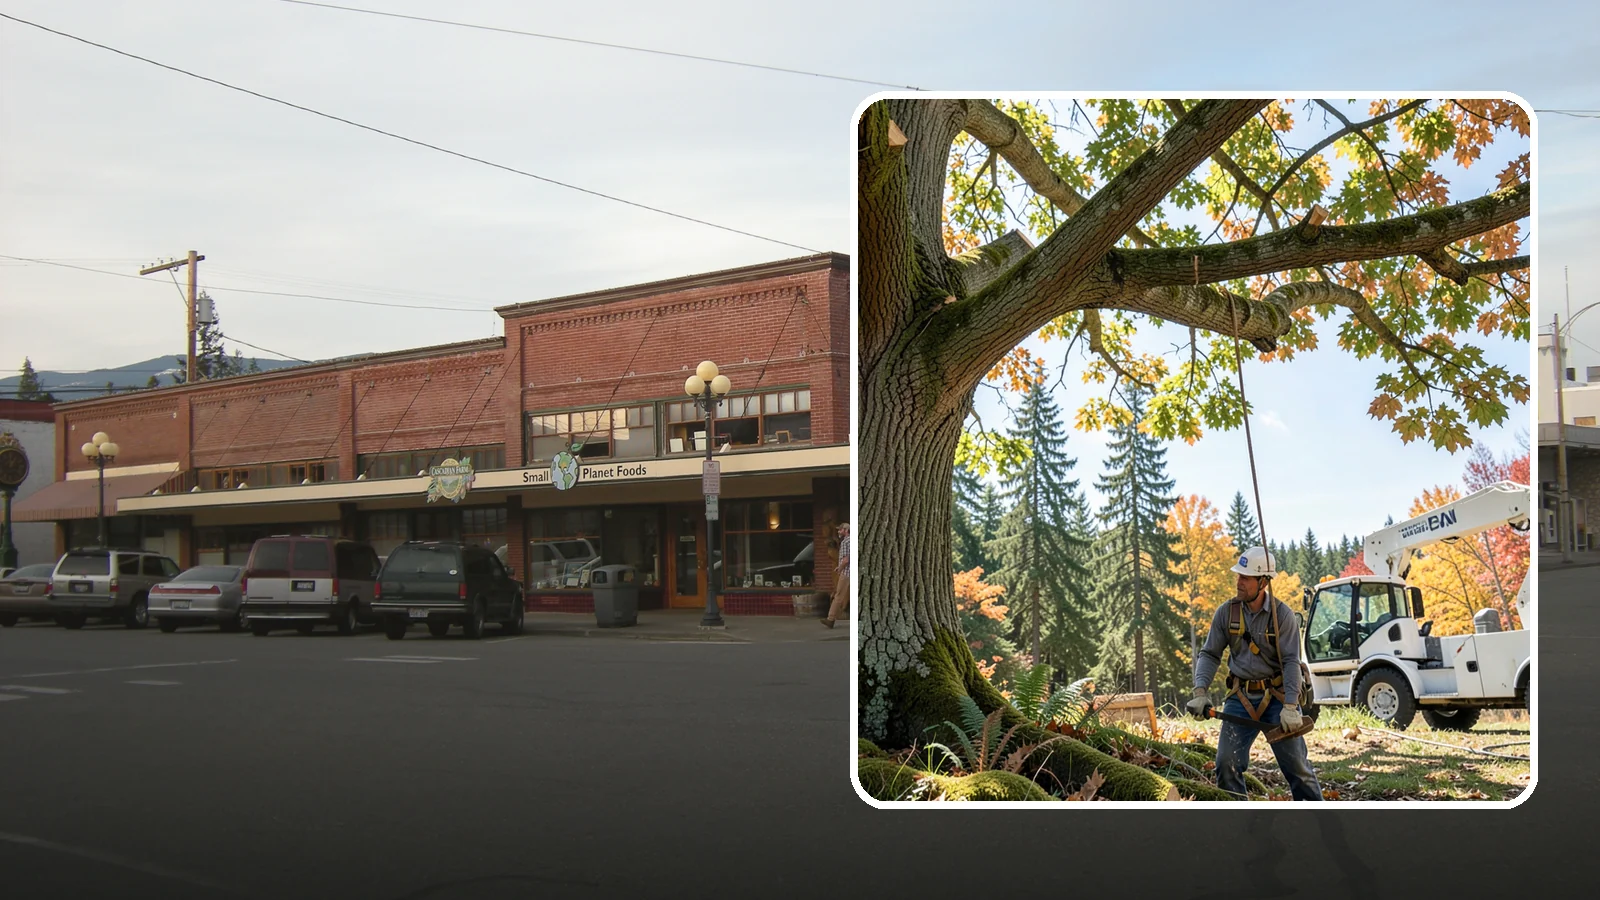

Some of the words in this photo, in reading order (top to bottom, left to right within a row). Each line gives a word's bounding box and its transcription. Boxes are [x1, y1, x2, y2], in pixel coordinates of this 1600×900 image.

[523, 471, 549, 483] Small
[582, 467, 614, 480] Planet
[616, 464, 647, 477] Foods
